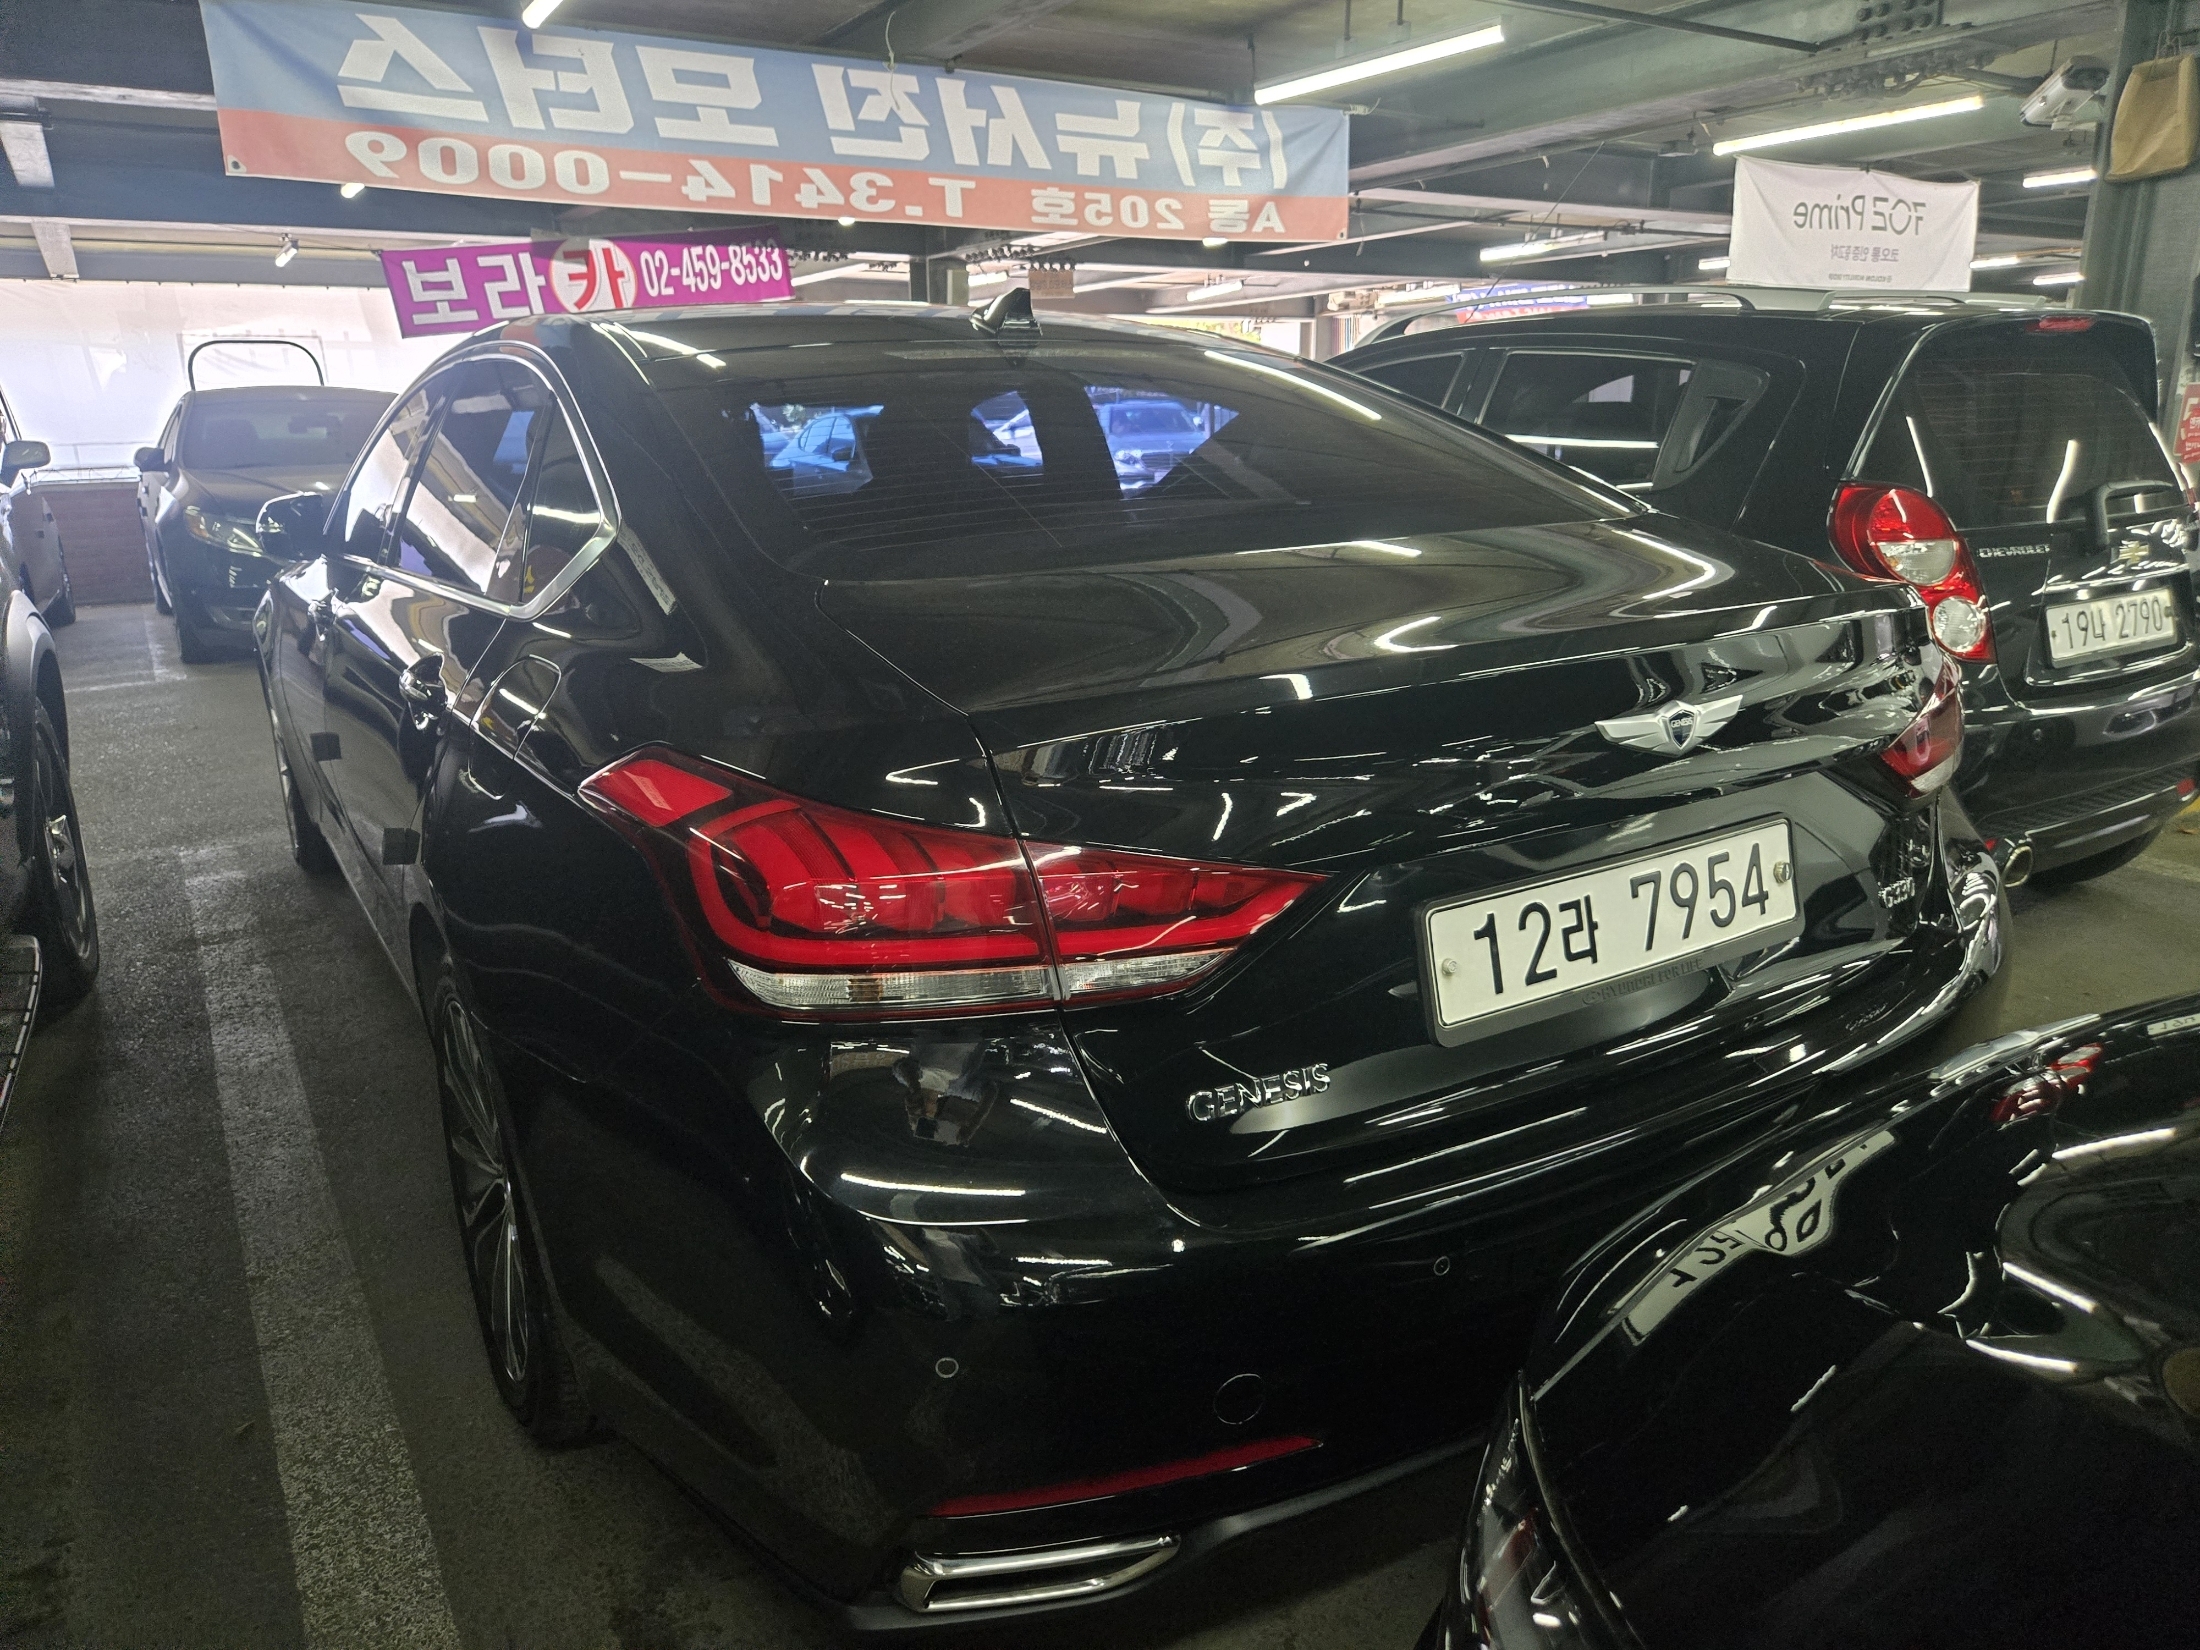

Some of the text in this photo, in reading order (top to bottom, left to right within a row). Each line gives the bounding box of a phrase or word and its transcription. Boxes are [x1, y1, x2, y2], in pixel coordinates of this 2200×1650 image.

[640, 237, 783, 297] 02-459-8533
[1977, 543, 2050, 558] CHEVROLET
[2115, 595, 2163, 639] 2790
[1670, 717, 1693, 728] GENESIS
[1473, 842, 1769, 995] 12라 7954
[1185, 1062, 1331, 1122] GENESIS
